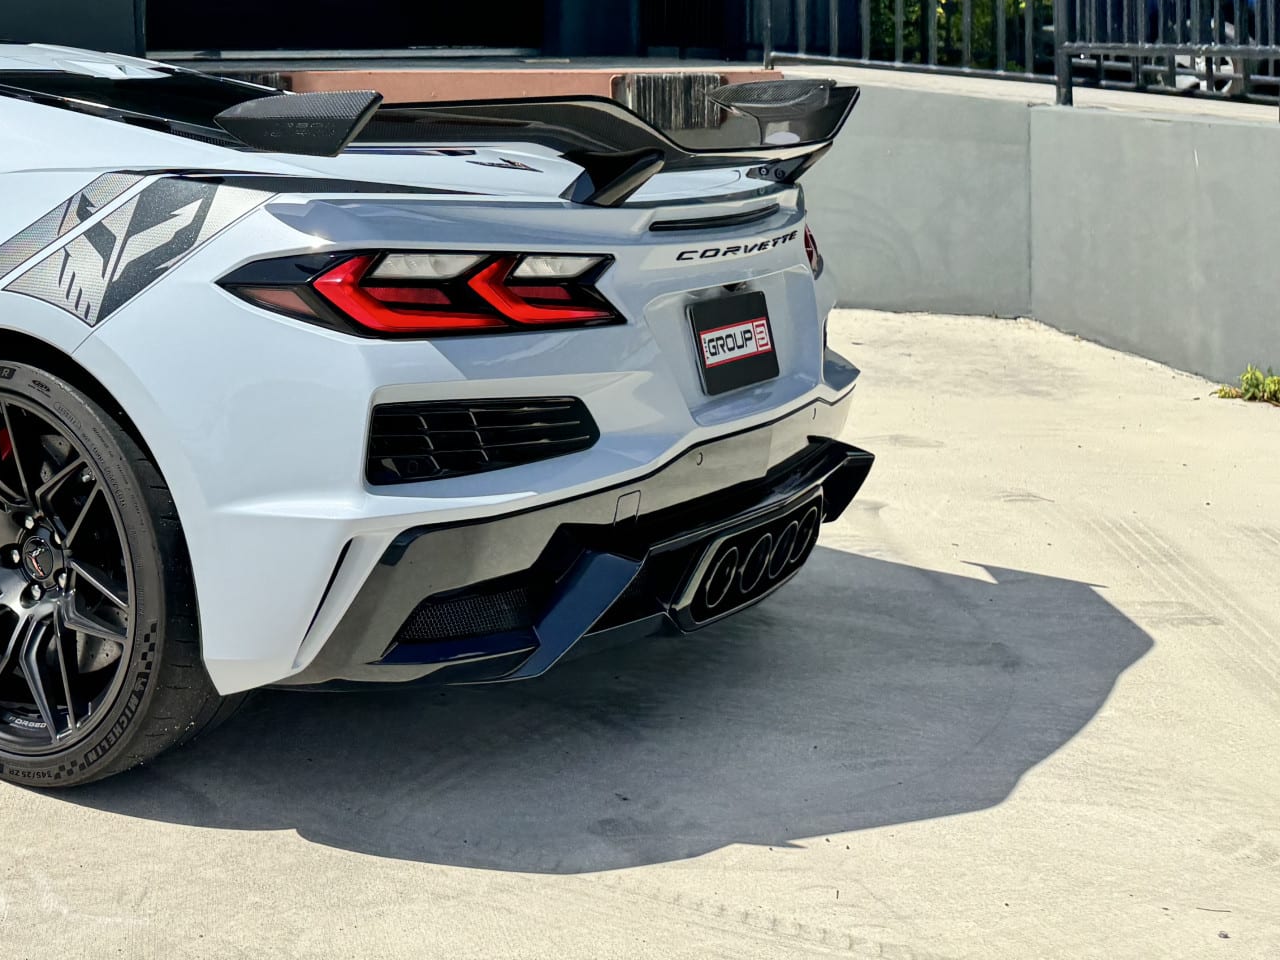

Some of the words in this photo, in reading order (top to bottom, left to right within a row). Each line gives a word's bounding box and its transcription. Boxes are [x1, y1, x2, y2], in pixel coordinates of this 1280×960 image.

[676, 230, 798, 261] CORVETTE
[707, 329, 753, 357] GROUP
[87, 694, 140, 763] MICHELIN
